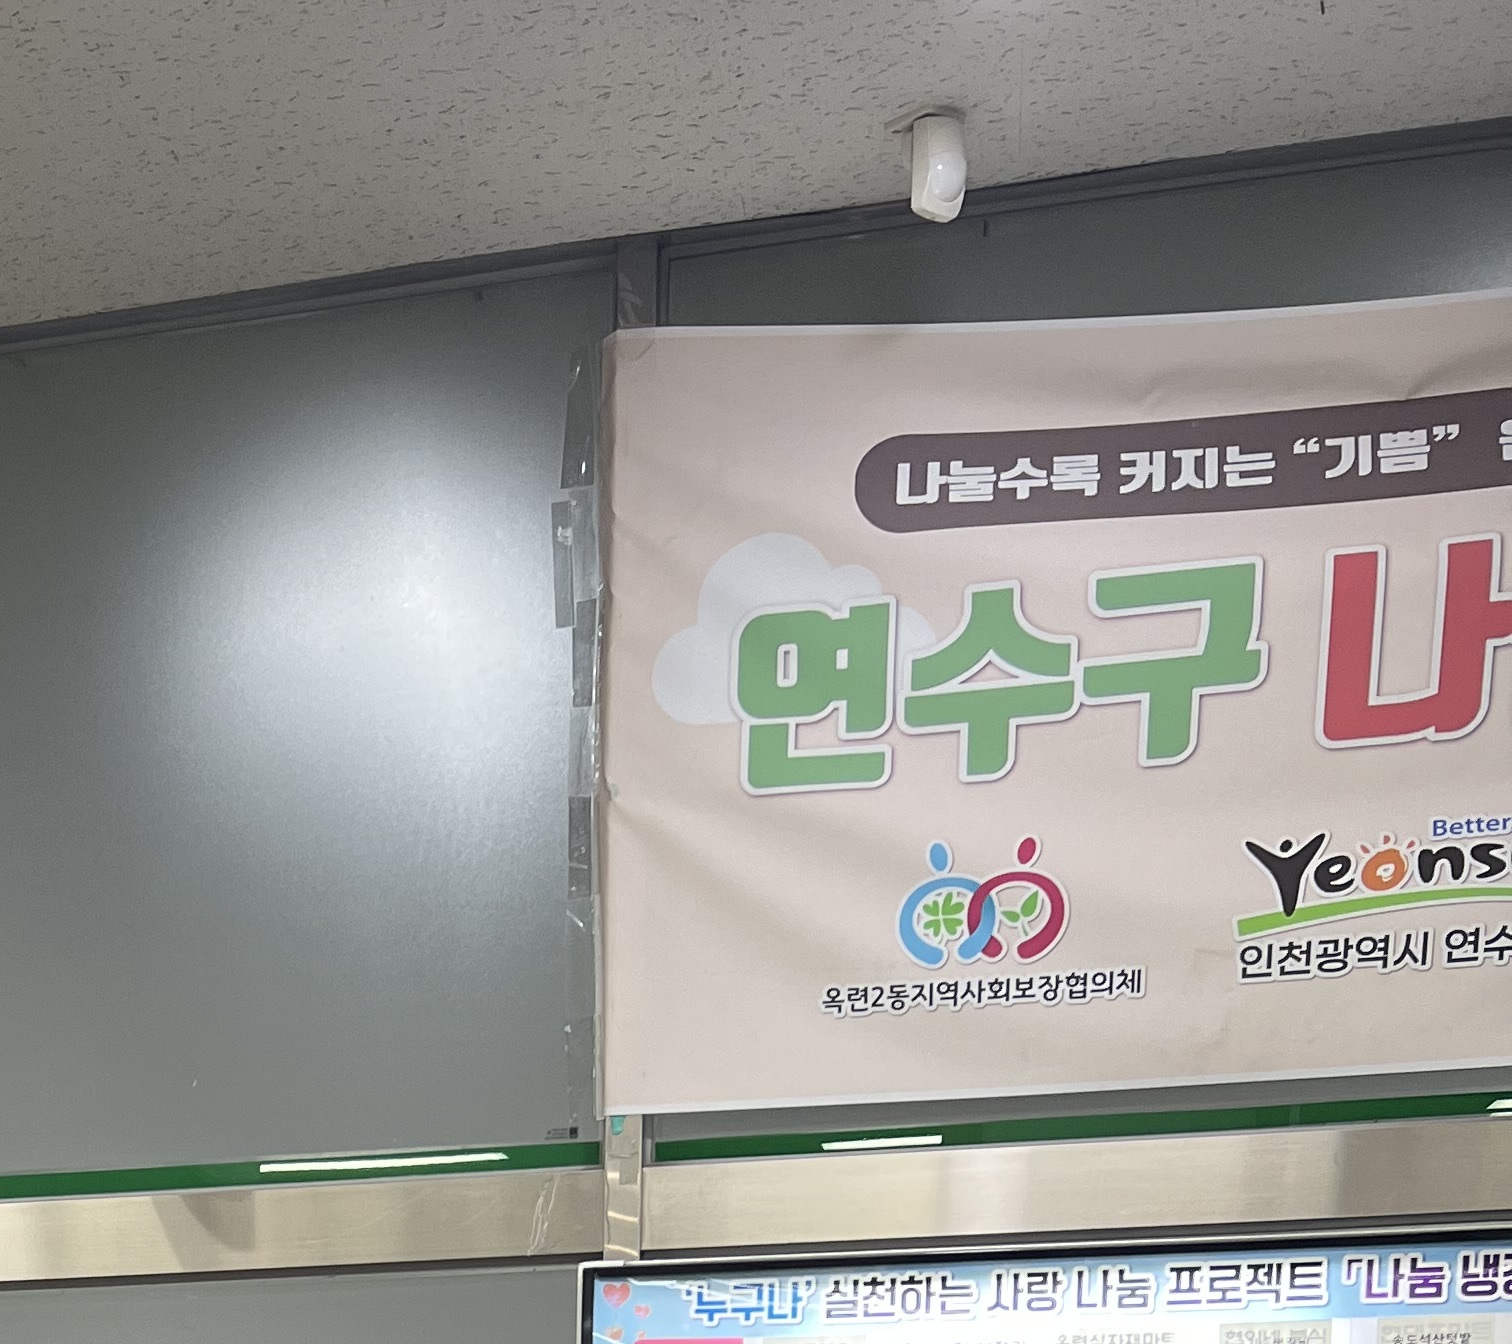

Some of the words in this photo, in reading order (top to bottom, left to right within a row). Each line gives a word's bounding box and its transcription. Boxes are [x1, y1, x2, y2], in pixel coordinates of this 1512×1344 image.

[895, 453, 1101, 506] 나눌수록
[1119, 446, 1276, 494] 커지는
[736, 560, 1265, 790] 연수구
[1245, 833, 1512, 917] Yeons
[1240, 931, 1429, 979] 인천광역시
[822, 968, 1142, 1013] 옥련2동지역사회보장협의체
[825, 1275, 974, 1319] 실천하는
[987, 1271, 1062, 1312] 사랑
[1076, 1267, 1152, 1310] 나눔
[1166, 1260, 1324, 1304] 프로젝트
